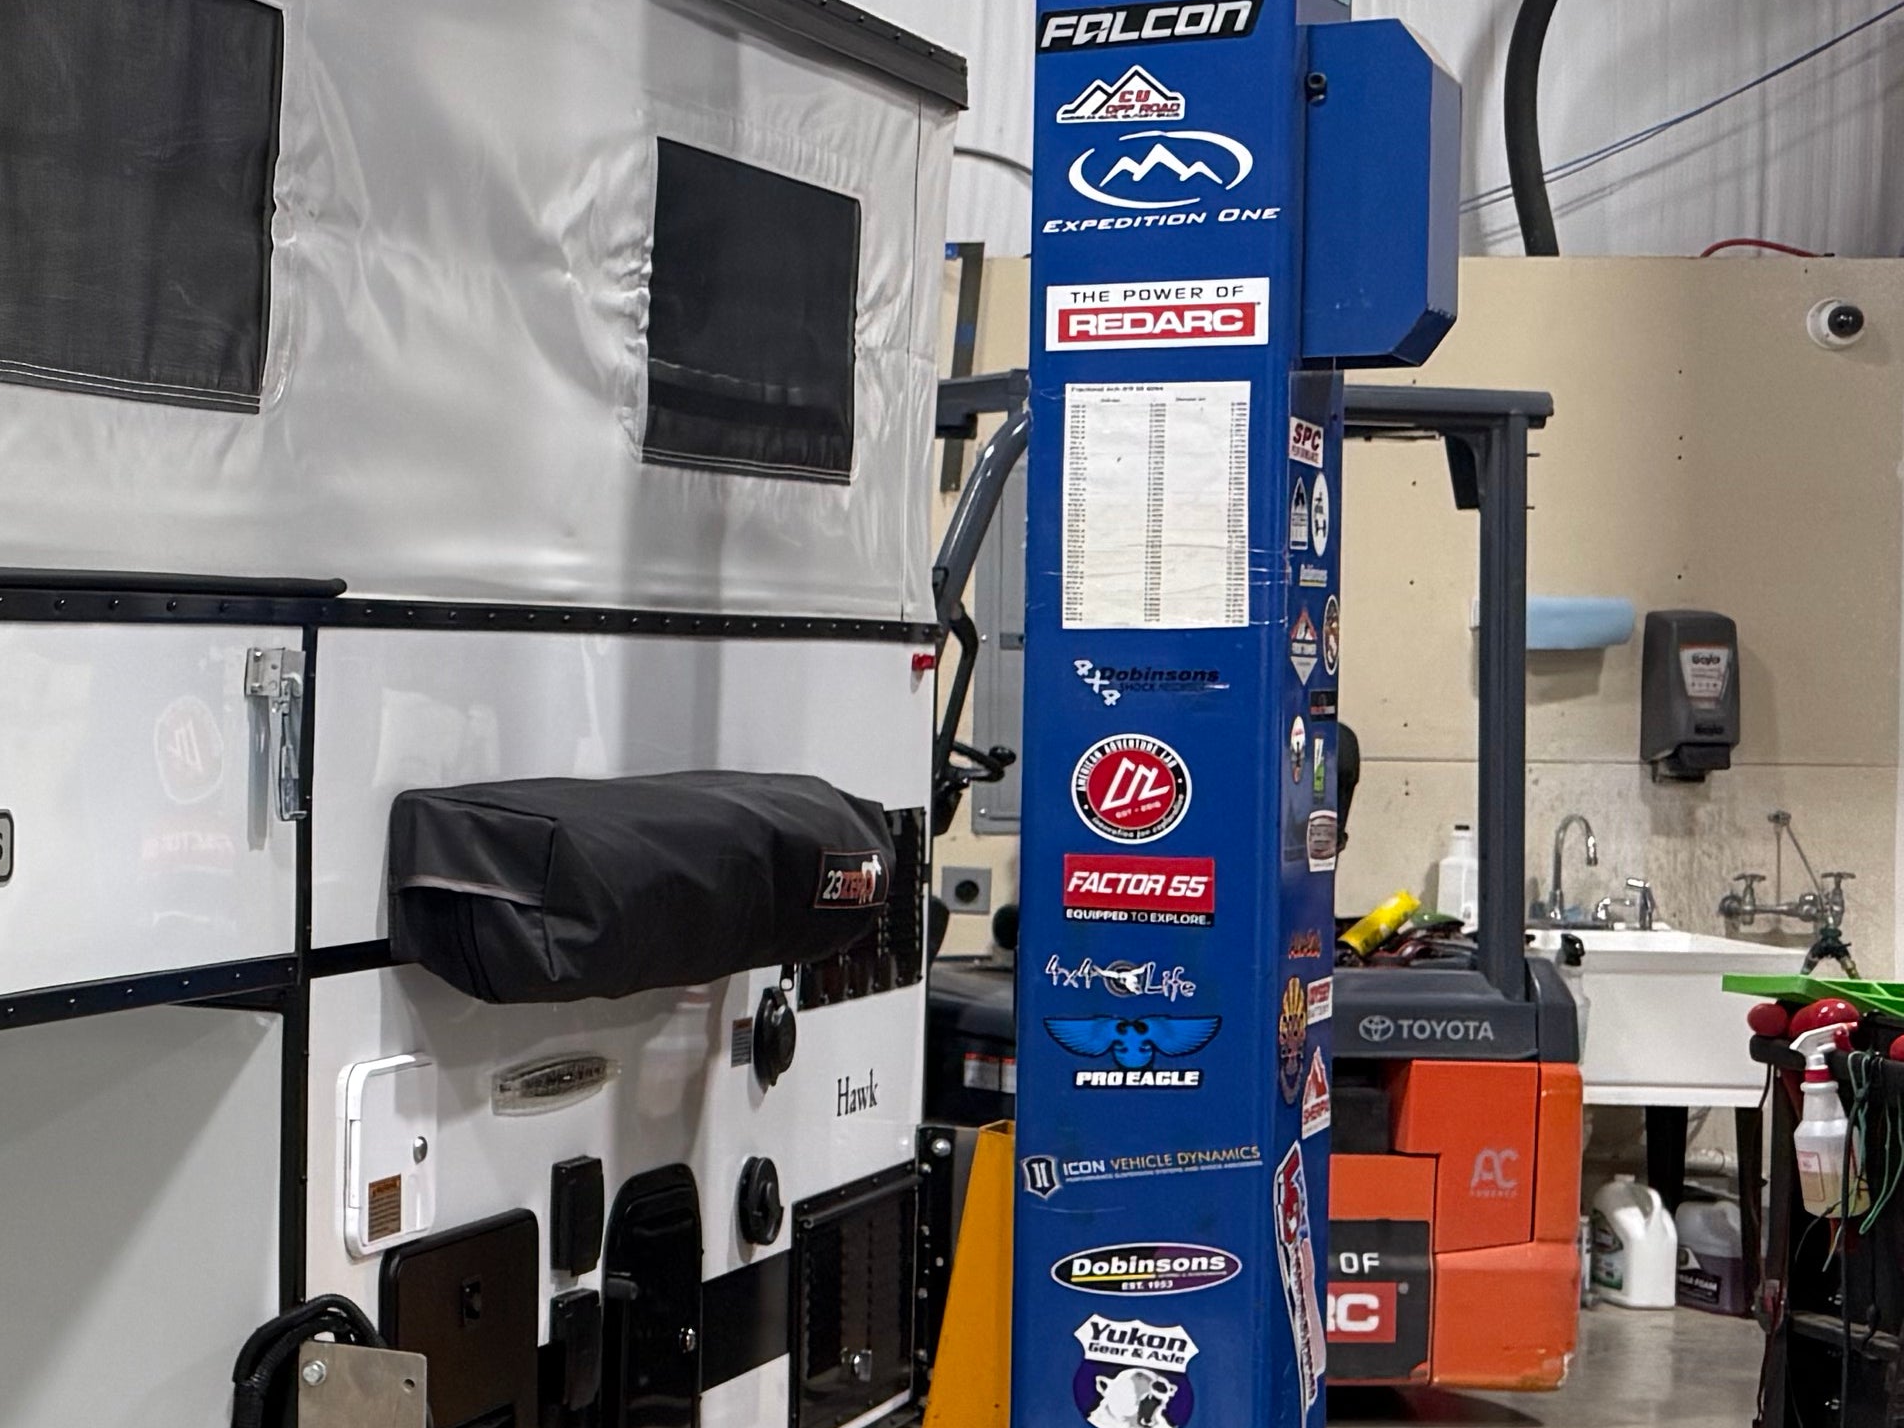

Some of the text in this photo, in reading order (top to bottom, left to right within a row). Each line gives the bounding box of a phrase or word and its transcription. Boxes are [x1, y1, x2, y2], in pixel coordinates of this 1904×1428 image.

[1040, 0, 1253, 48] FALCON
[1138, 102, 1180, 113] ROAD
[1042, 208, 1281, 233] EXPEDITION ONE
[1070, 285, 1245, 304] THE POWER OF
[1068, 309, 1244, 337] REDARC
[1293, 422, 1322, 451] SPC
[1067, 871, 1166, 896] FACTOR
[1066, 908, 1128, 921] EQUIPPED
[1131, 911, 1148, 922] TO
[1397, 1019, 1494, 1040] TOYOTA
[1076, 1071, 1200, 1086] PRO EAGLE
[837, 1068, 878, 1117] Hawk
[1062, 1160, 1106, 1176] ICON
[1109, 1154, 1173, 1171] VEHICLE
[1177, 1145, 1261, 1165] DYNAMICS
[1470, 1149, 1518, 1189] AC
[1071, 1255, 1226, 1277] Dobinsons
[1339, 1252, 1380, 1274] OF
[1121, 1281, 1143, 1291] EST.
[1090, 1322, 1188, 1352] Yukon
[1088, 1342, 1185, 1364] Gear & Axle
